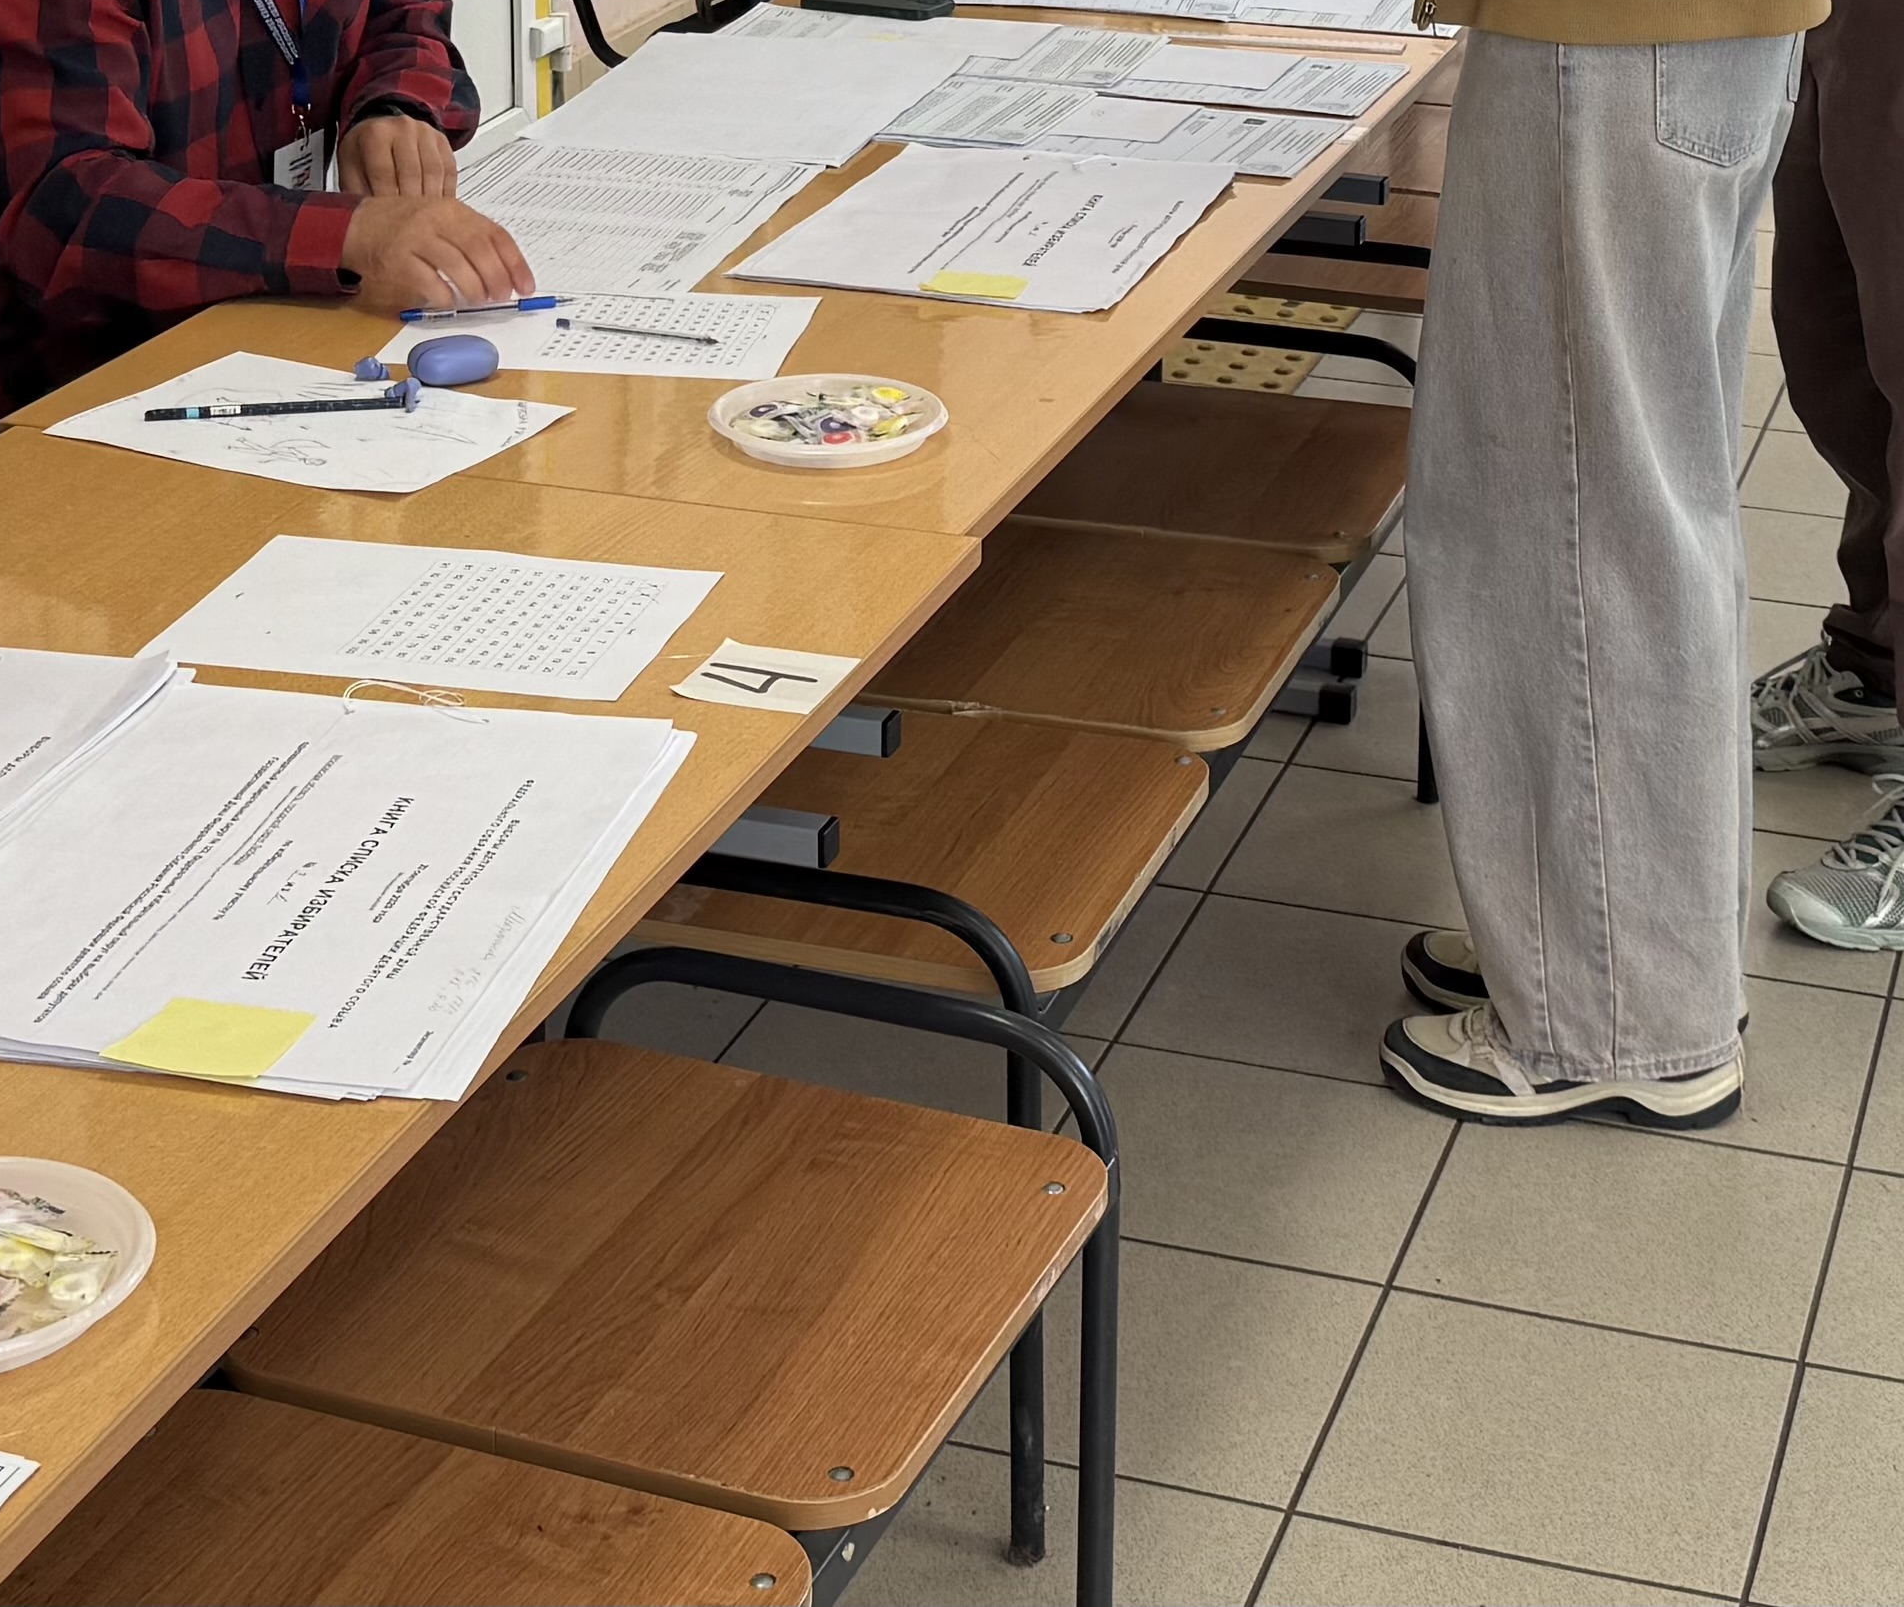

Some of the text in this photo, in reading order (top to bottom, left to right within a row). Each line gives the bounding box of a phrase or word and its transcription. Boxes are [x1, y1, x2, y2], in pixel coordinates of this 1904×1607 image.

[699, 661, 819, 695] 4
[489, 778, 536, 828] ФЕДЕРАЛЬНОГО
[460, 828, 496, 866] СОБРАНИЯ
[491, 818, 522, 851] ВЫБОРЫ
[242, 796, 415, 981] КНИГА СПИСКА ИЗБИРАТЕЛЕЙ
[424, 865, 468, 911] РОССИЙСКОЙ
[387, 910, 429, 954] ФЕДЕРАЦИИ
[404, 885, 466, 958] ГОСУДАРСТВЕННОЙ
[354, 953, 394, 995] ДЕВЯТОГО
[327, 994, 361, 1030] СОЗЫВА
